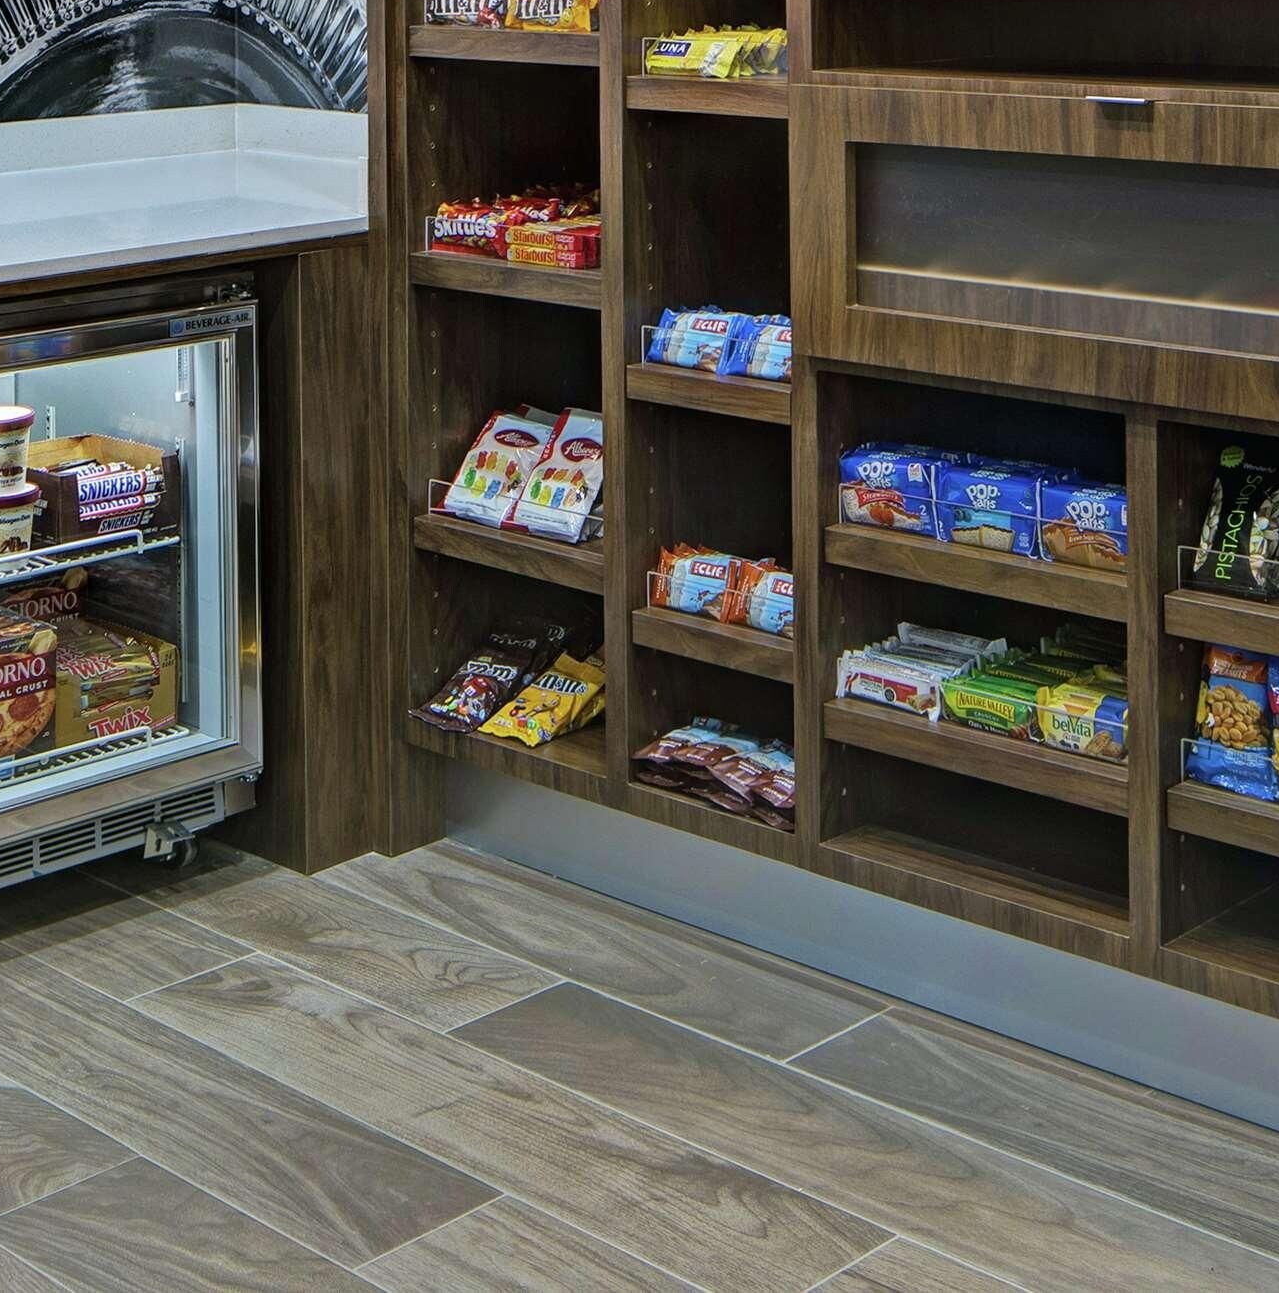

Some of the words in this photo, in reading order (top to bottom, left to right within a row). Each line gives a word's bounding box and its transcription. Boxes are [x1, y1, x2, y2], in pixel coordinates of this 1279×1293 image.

[654, 41, 689, 55] LUNA
[433, 216, 497, 239] Skittles
[185, 312, 250, 331] BEVERAGE-AIR
[79, 473, 142, 502] SNICKERS
[99, 514, 141, 532] SNICKERS
[1215, 474, 1263, 581] PISTACHIOS
[16, 680, 49, 696] CRUST
[959, 692, 985, 709] NATURE
[983, 699, 1014, 720] VALLEY
[1051, 714, 1092, 738] belVita
